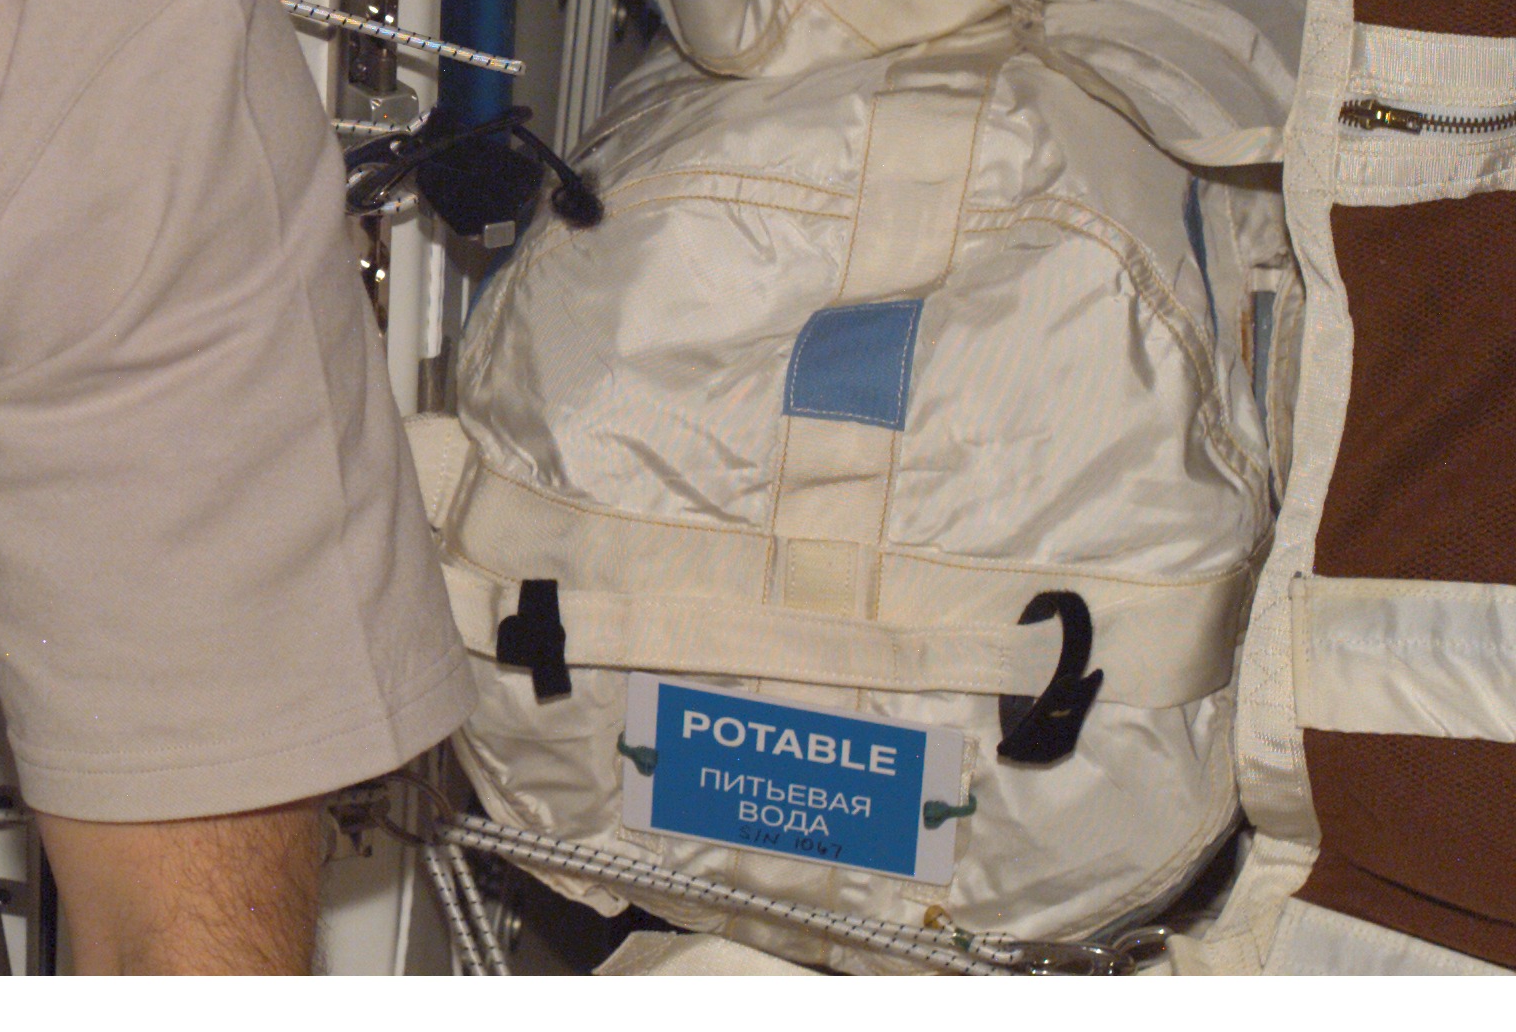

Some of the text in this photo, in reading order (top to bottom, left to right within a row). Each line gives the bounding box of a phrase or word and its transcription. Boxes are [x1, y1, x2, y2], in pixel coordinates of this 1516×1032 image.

[682, 709, 898, 777] POTABLE
[700, 766, 872, 818] ПИТЬЕВАЯ
[738, 800, 830, 837] ВОДА
